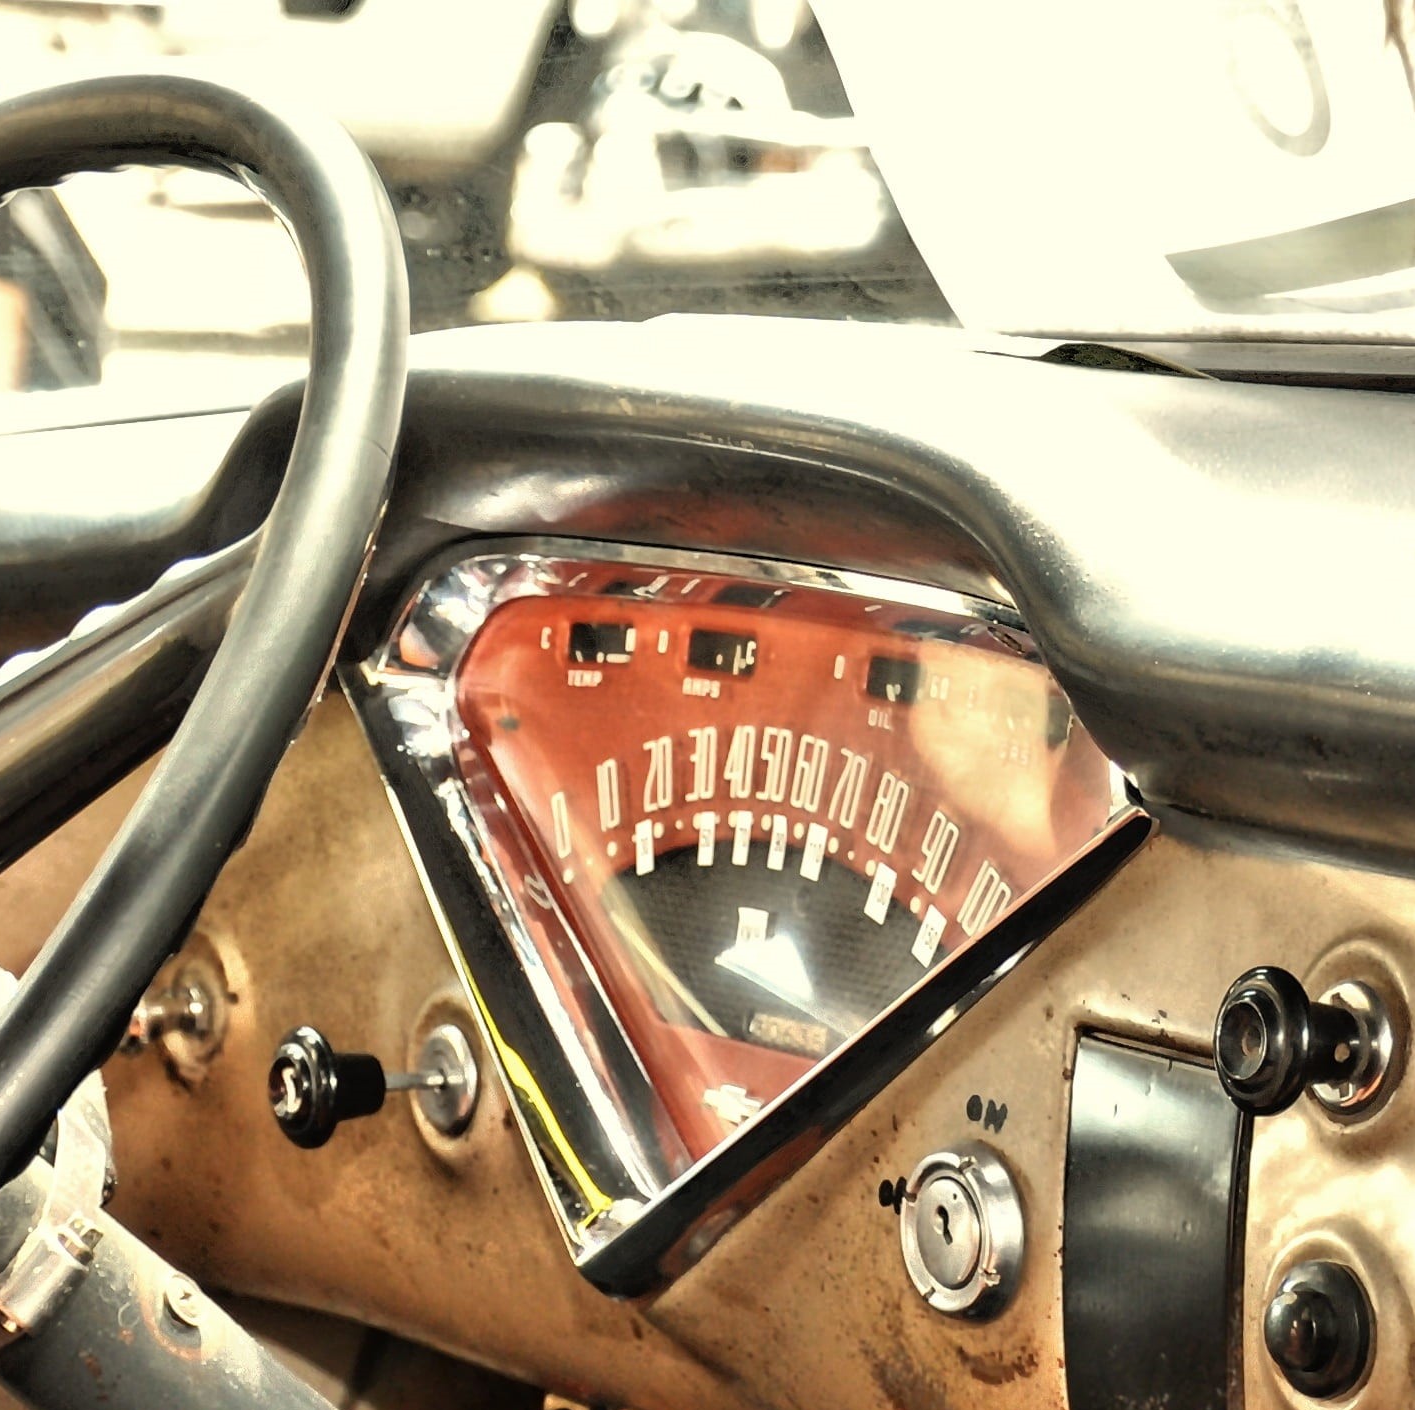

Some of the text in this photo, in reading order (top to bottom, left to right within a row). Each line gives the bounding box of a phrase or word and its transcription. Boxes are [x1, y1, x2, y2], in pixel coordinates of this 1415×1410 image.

[541, 627, 552, 649] C
[567, 670, 603, 687] TEMP
[683, 677, 720, 698] AMPS
[867, 708, 894, 731] OIL
[595, 758, 621, 832] 10
[642, 735, 674, 813] 20
[684, 725, 718, 803] 30
[722, 724, 756, 800] 40
[755, 727, 793, 804] 50
[790, 733, 829, 813] 60
[828, 747, 868, 830] 70
[550, 790, 572, 859] 0
[865, 770, 910, 855] 80
[911, 809, 960, 895] 90
[957, 858, 1013, 938] 100
[966, 1094, 1009, 1134] ON
